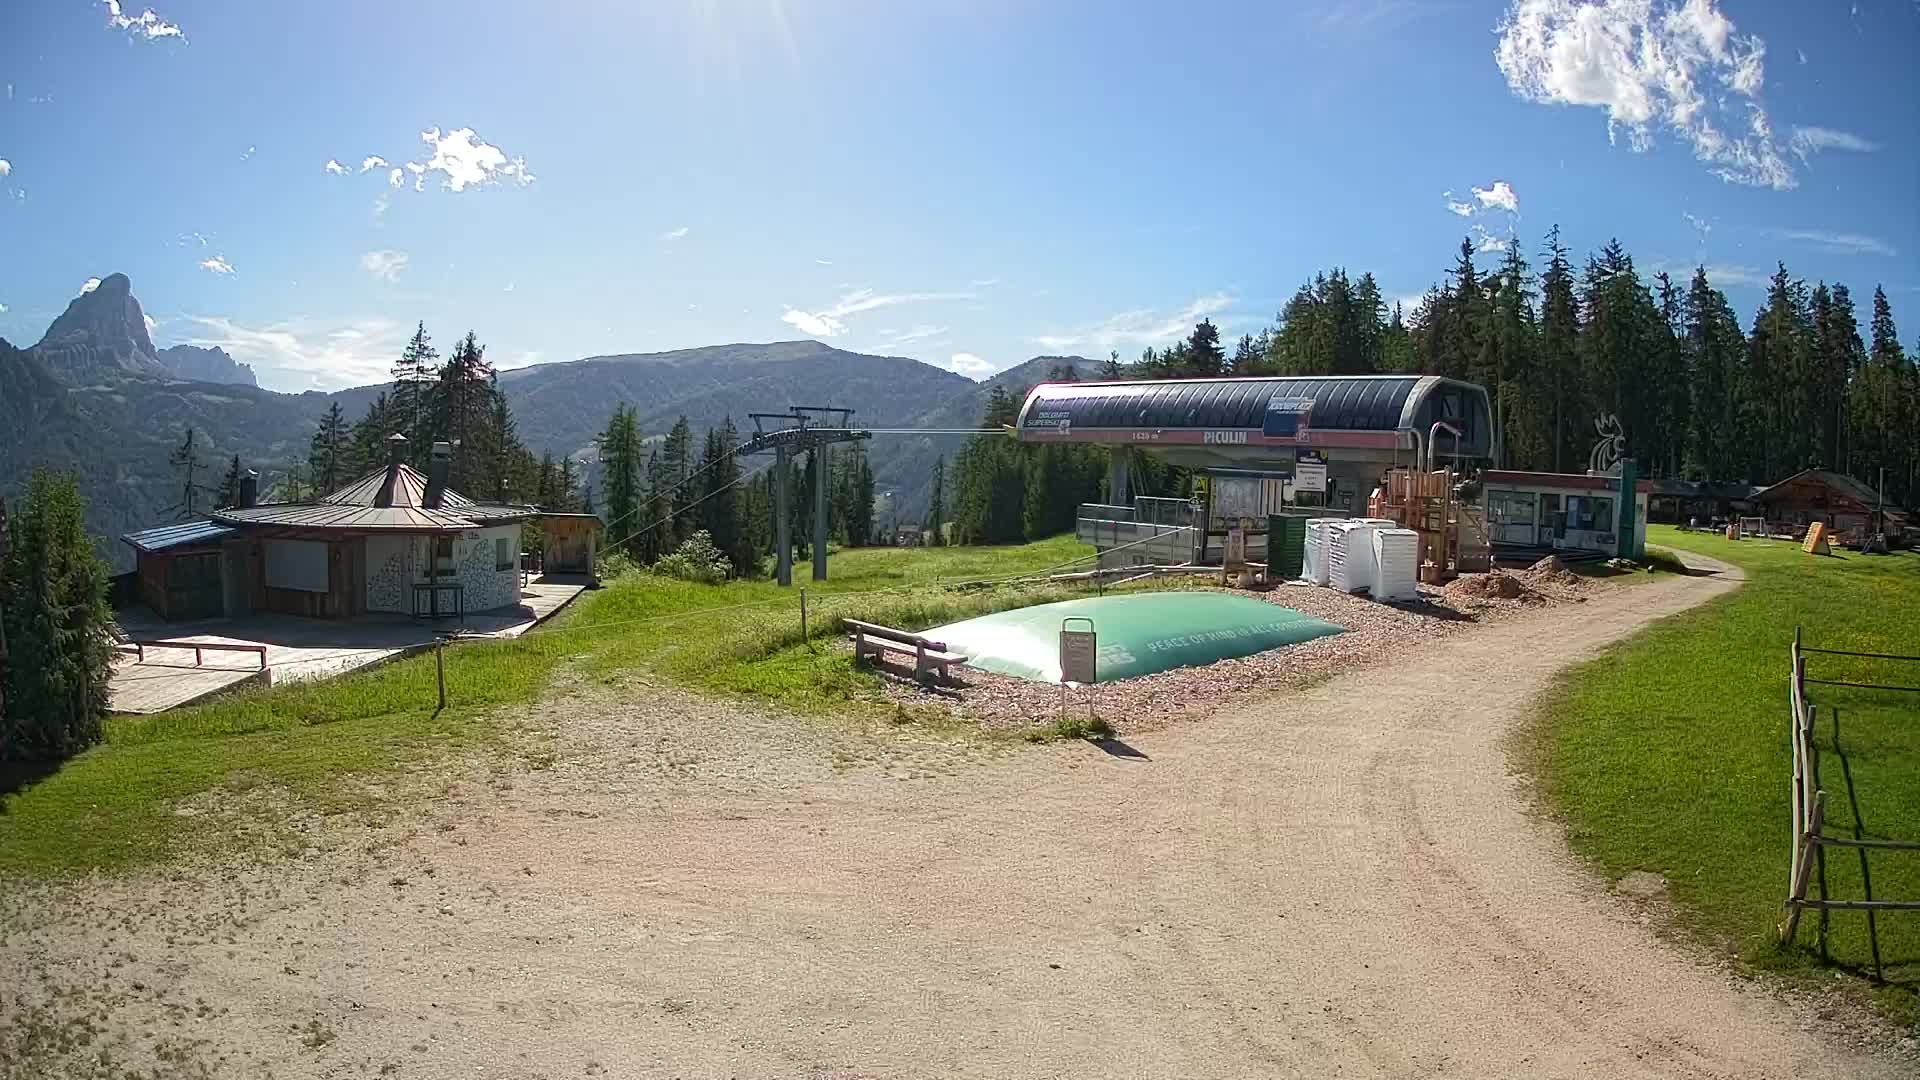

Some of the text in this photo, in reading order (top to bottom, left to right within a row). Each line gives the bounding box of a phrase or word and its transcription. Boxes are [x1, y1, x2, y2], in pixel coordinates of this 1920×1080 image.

[1203, 431, 1248, 444] PICULIN
[1147, 636, 1190, 652] PEACE
[1190, 634, 1207, 646] OF
